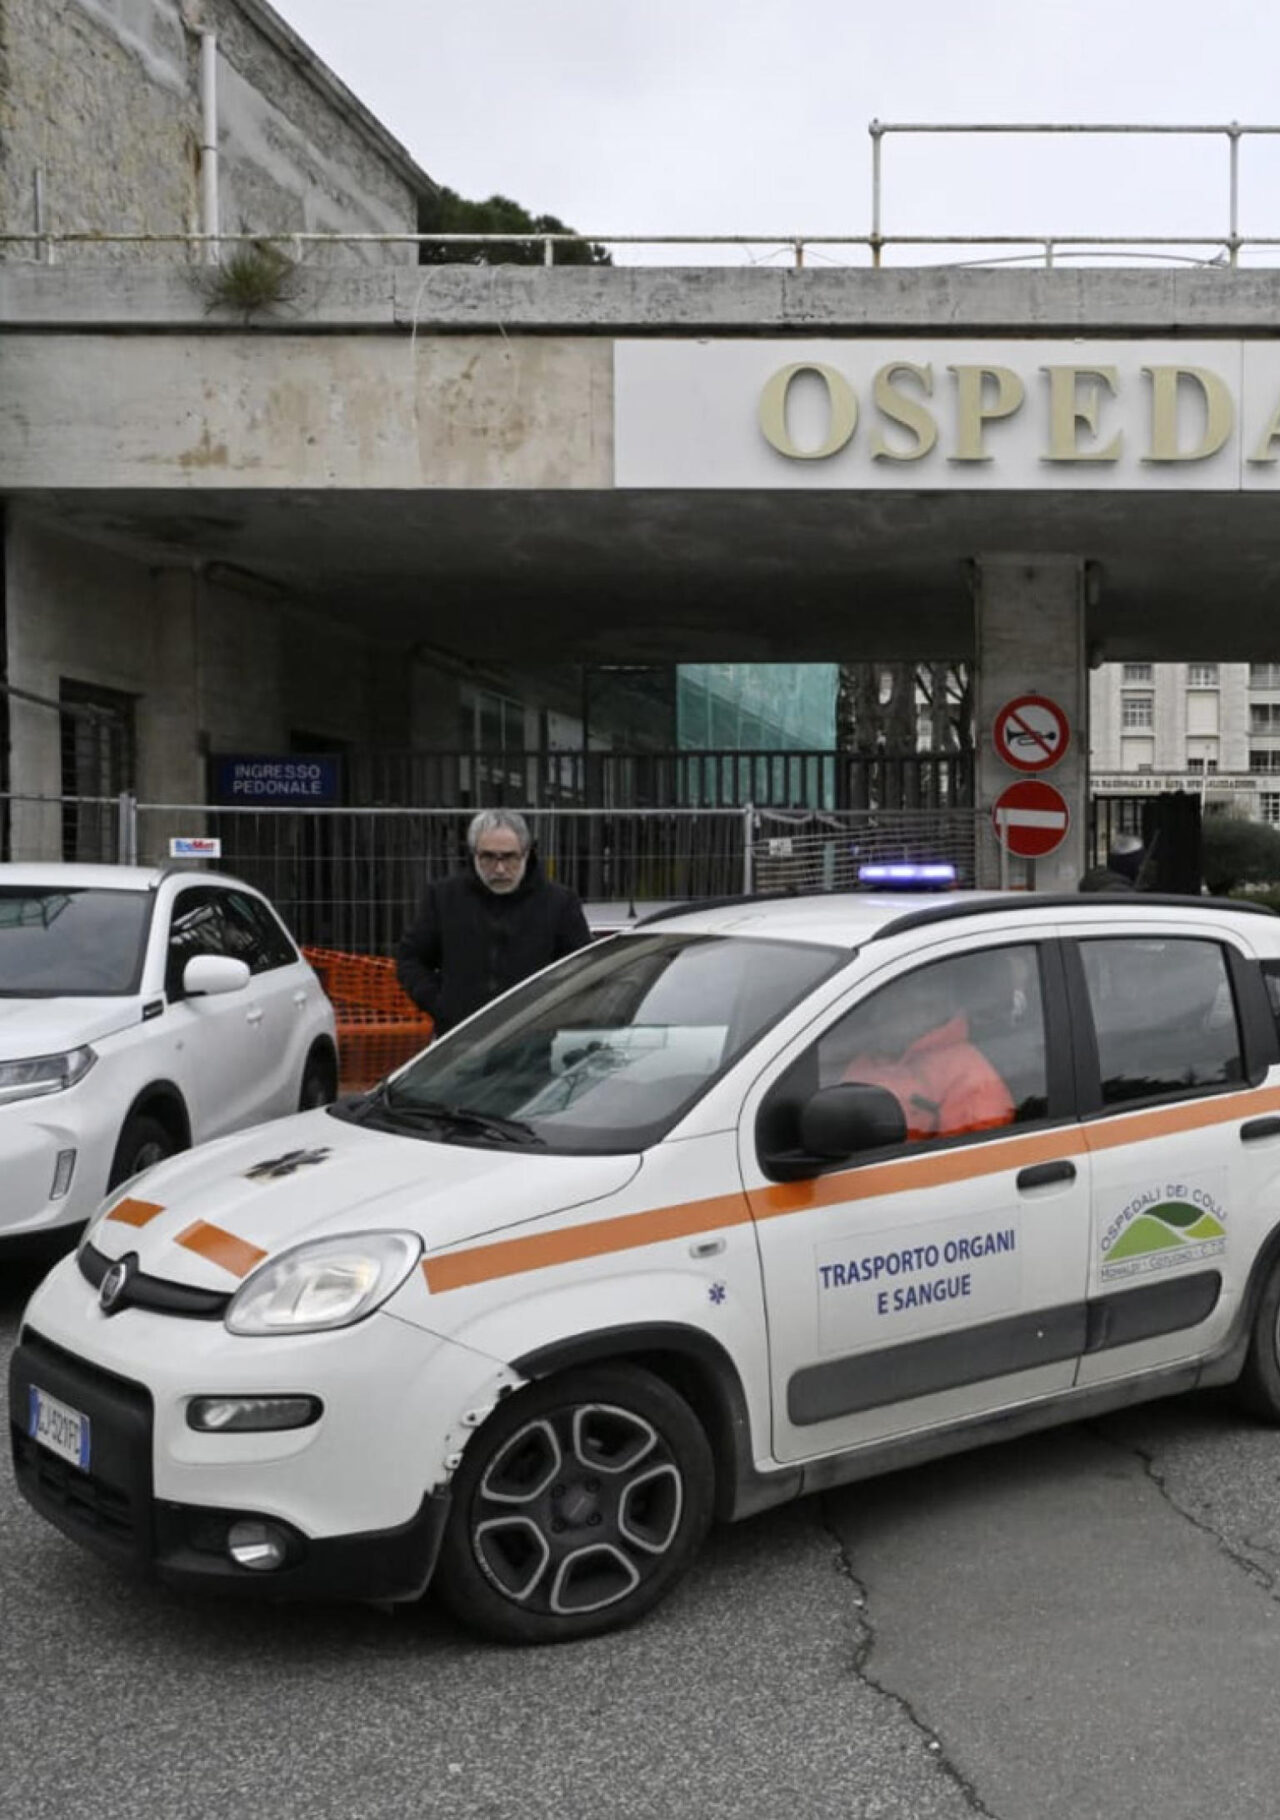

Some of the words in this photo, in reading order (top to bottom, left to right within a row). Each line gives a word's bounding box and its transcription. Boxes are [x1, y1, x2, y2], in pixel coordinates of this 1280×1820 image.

[233, 780, 322, 795] PEDONALE
[234, 764, 322, 779] INGRESSO
[1100, 1187, 1161, 1251] OSPEDALI
[1166, 1184, 1188, 1198] DEI
[1192, 1189, 1228, 1222] COLLI
[819, 1244, 940, 1290] TRASPORTO
[943, 1229, 1016, 1265] ORGANI
[877, 1291, 889, 1315] E
[893, 1273, 972, 1312] SANGUE
